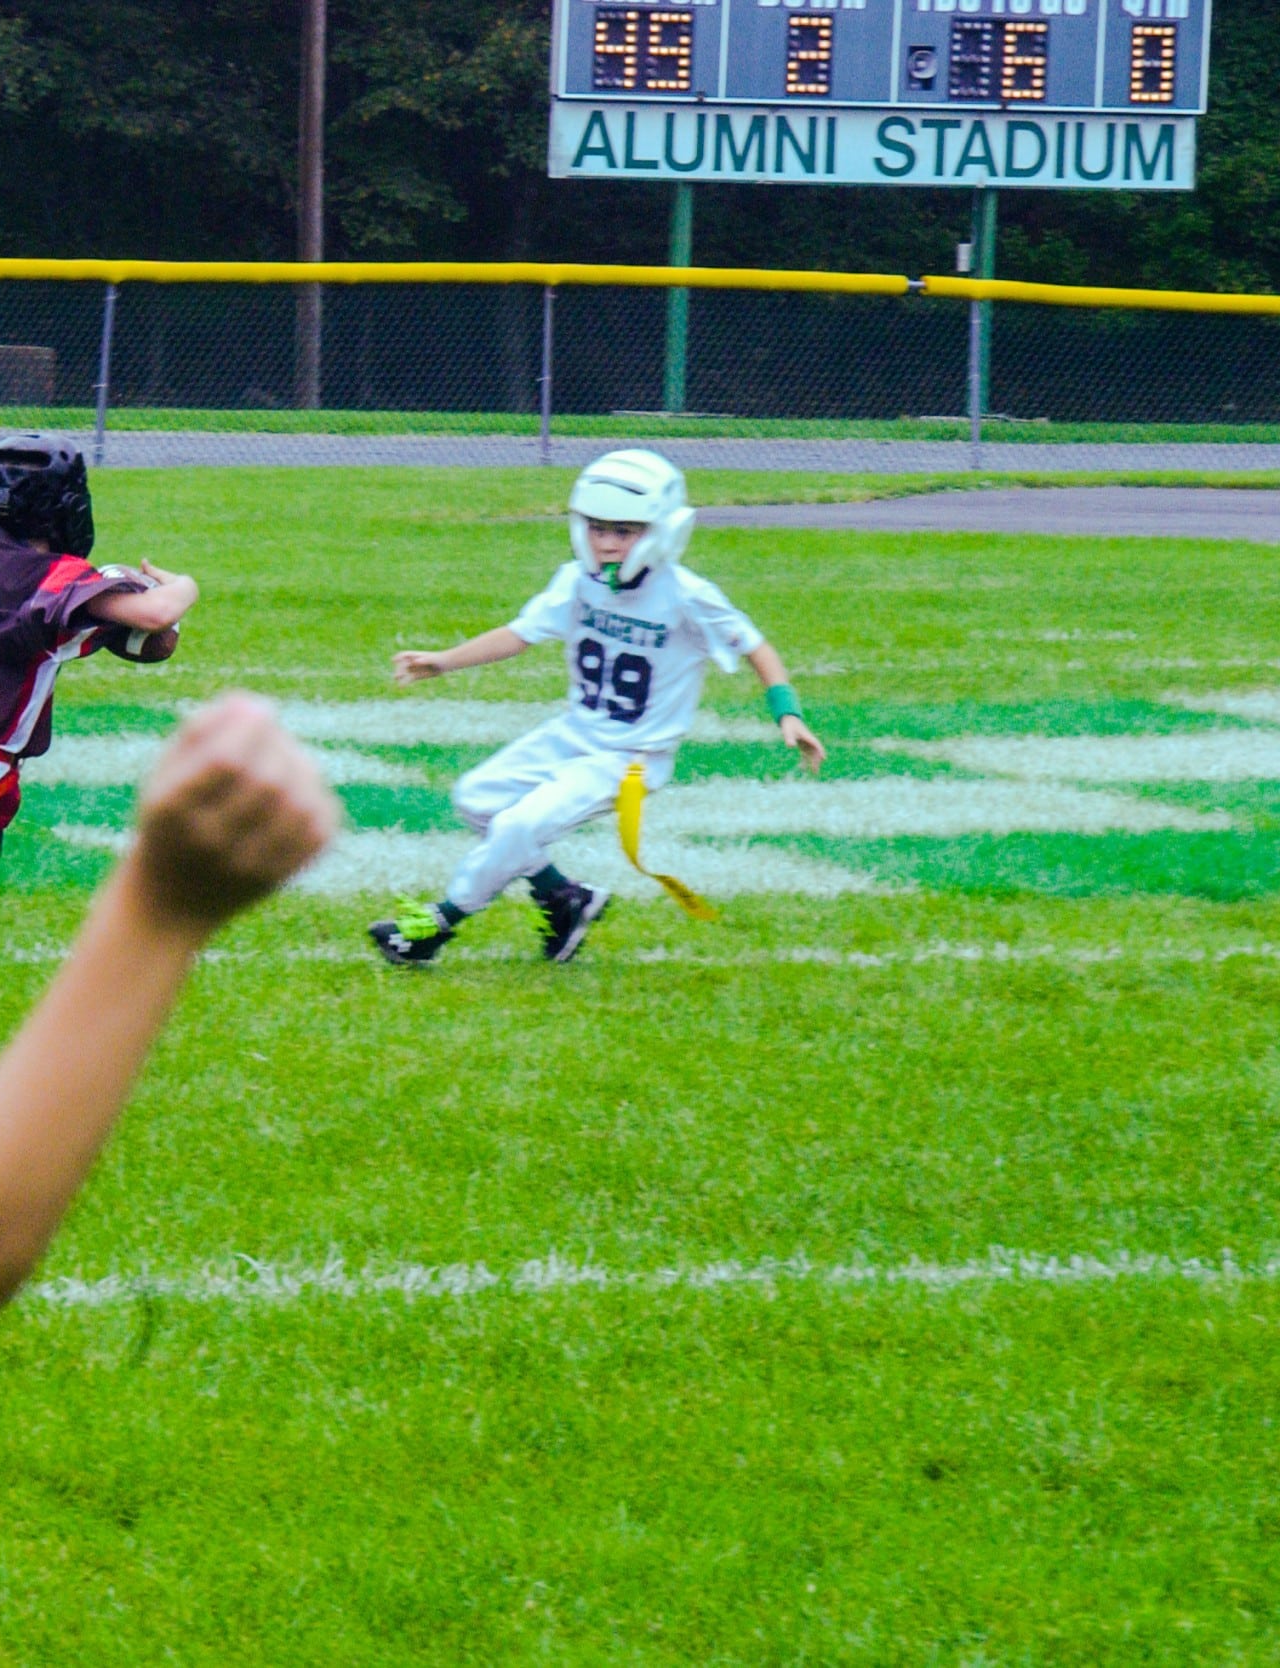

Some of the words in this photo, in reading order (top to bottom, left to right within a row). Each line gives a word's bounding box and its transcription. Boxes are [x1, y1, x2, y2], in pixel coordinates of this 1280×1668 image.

[786, 16, 833, 94] 2
[571, 109, 837, 175] ALUMNI
[873, 115, 1176, 181] STADIUM
[577, 637, 652, 724] 99
